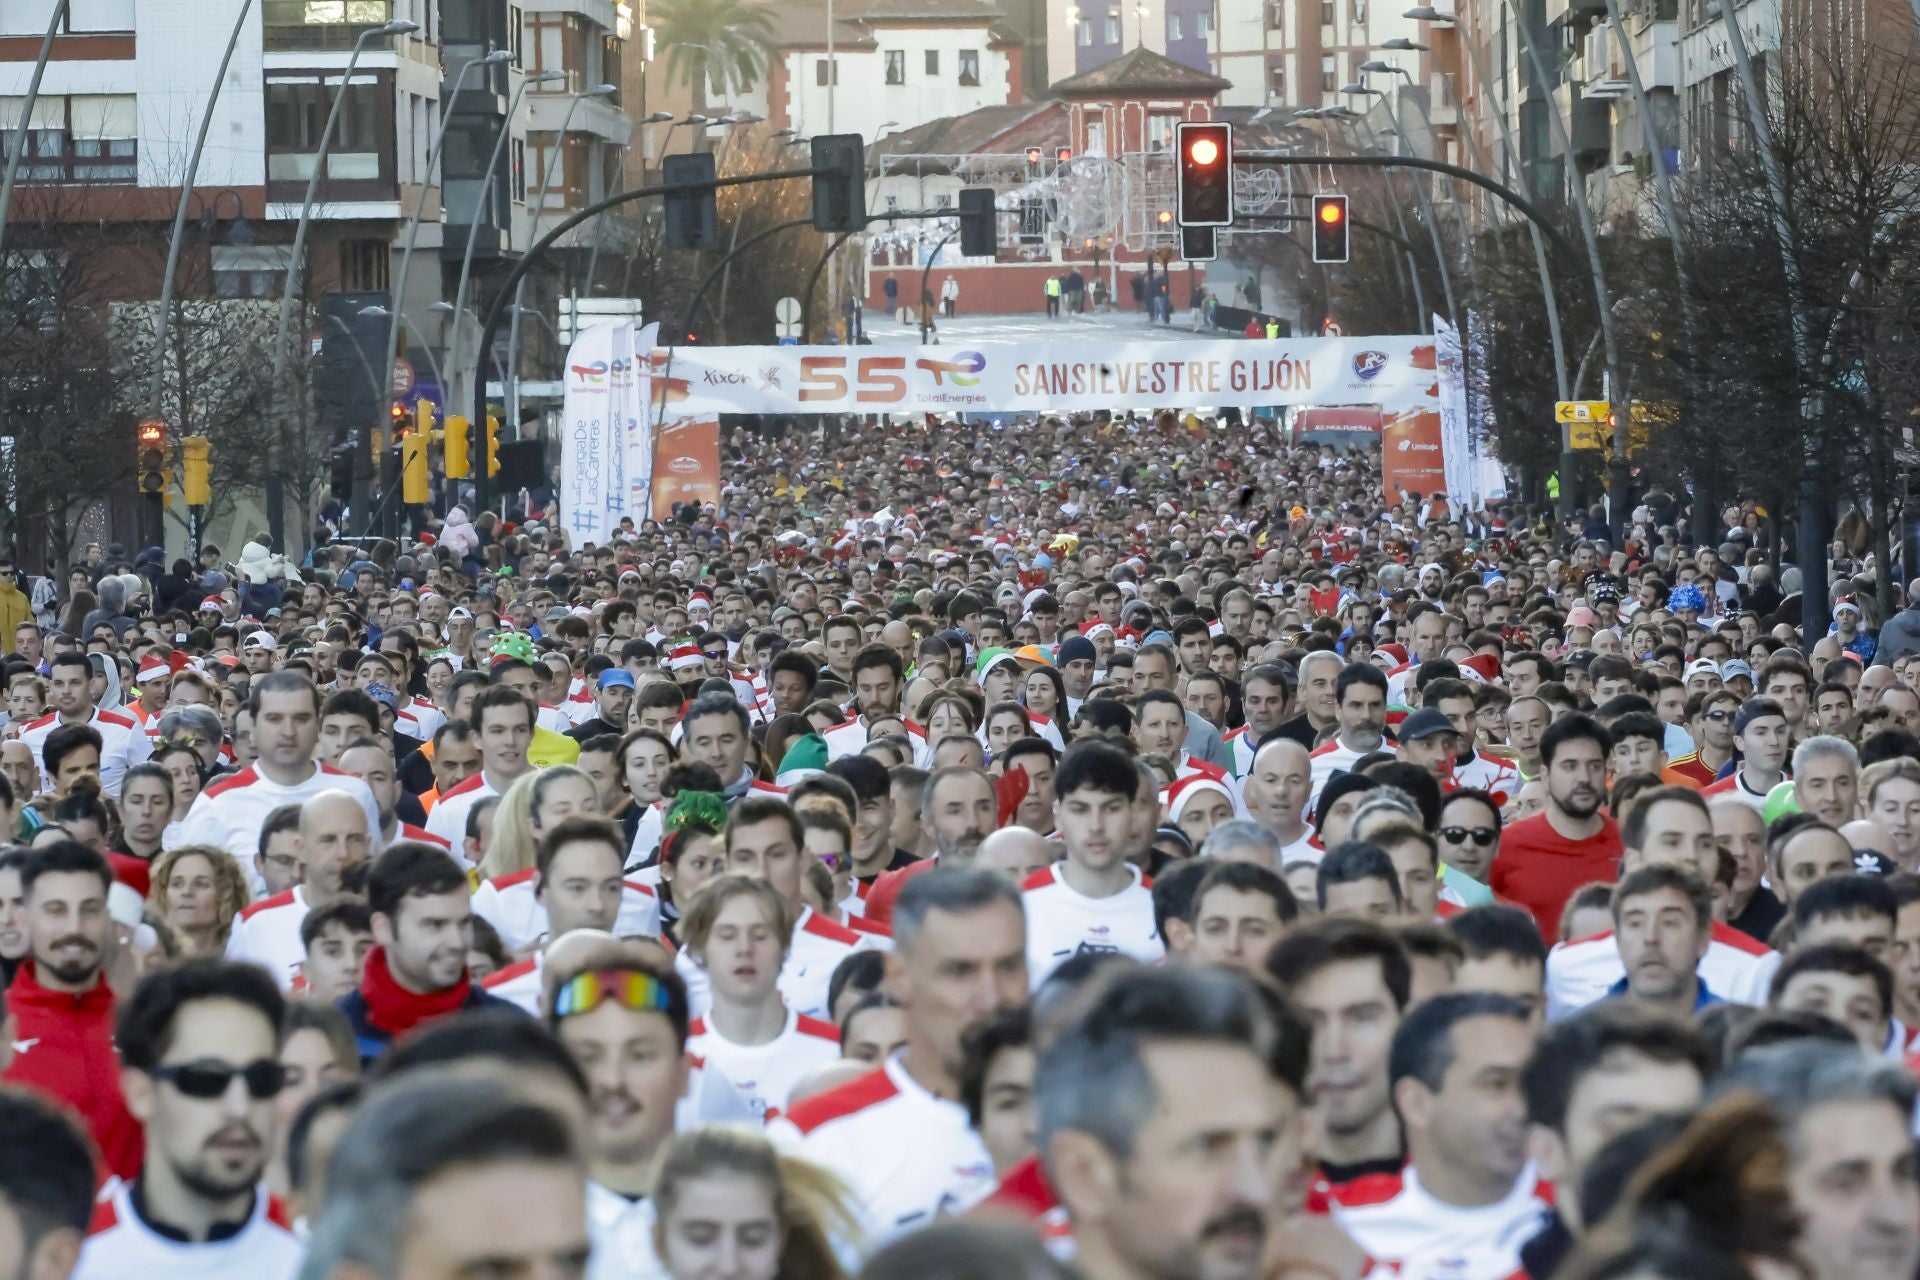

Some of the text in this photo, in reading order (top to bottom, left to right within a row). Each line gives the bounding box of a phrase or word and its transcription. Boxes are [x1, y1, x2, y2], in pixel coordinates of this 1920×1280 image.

[798, 356, 907, 402] 55
[1014, 352, 1312, 396] SANSILVESTRE GIJÓN
[916, 393, 987, 405] TotalEnergies
